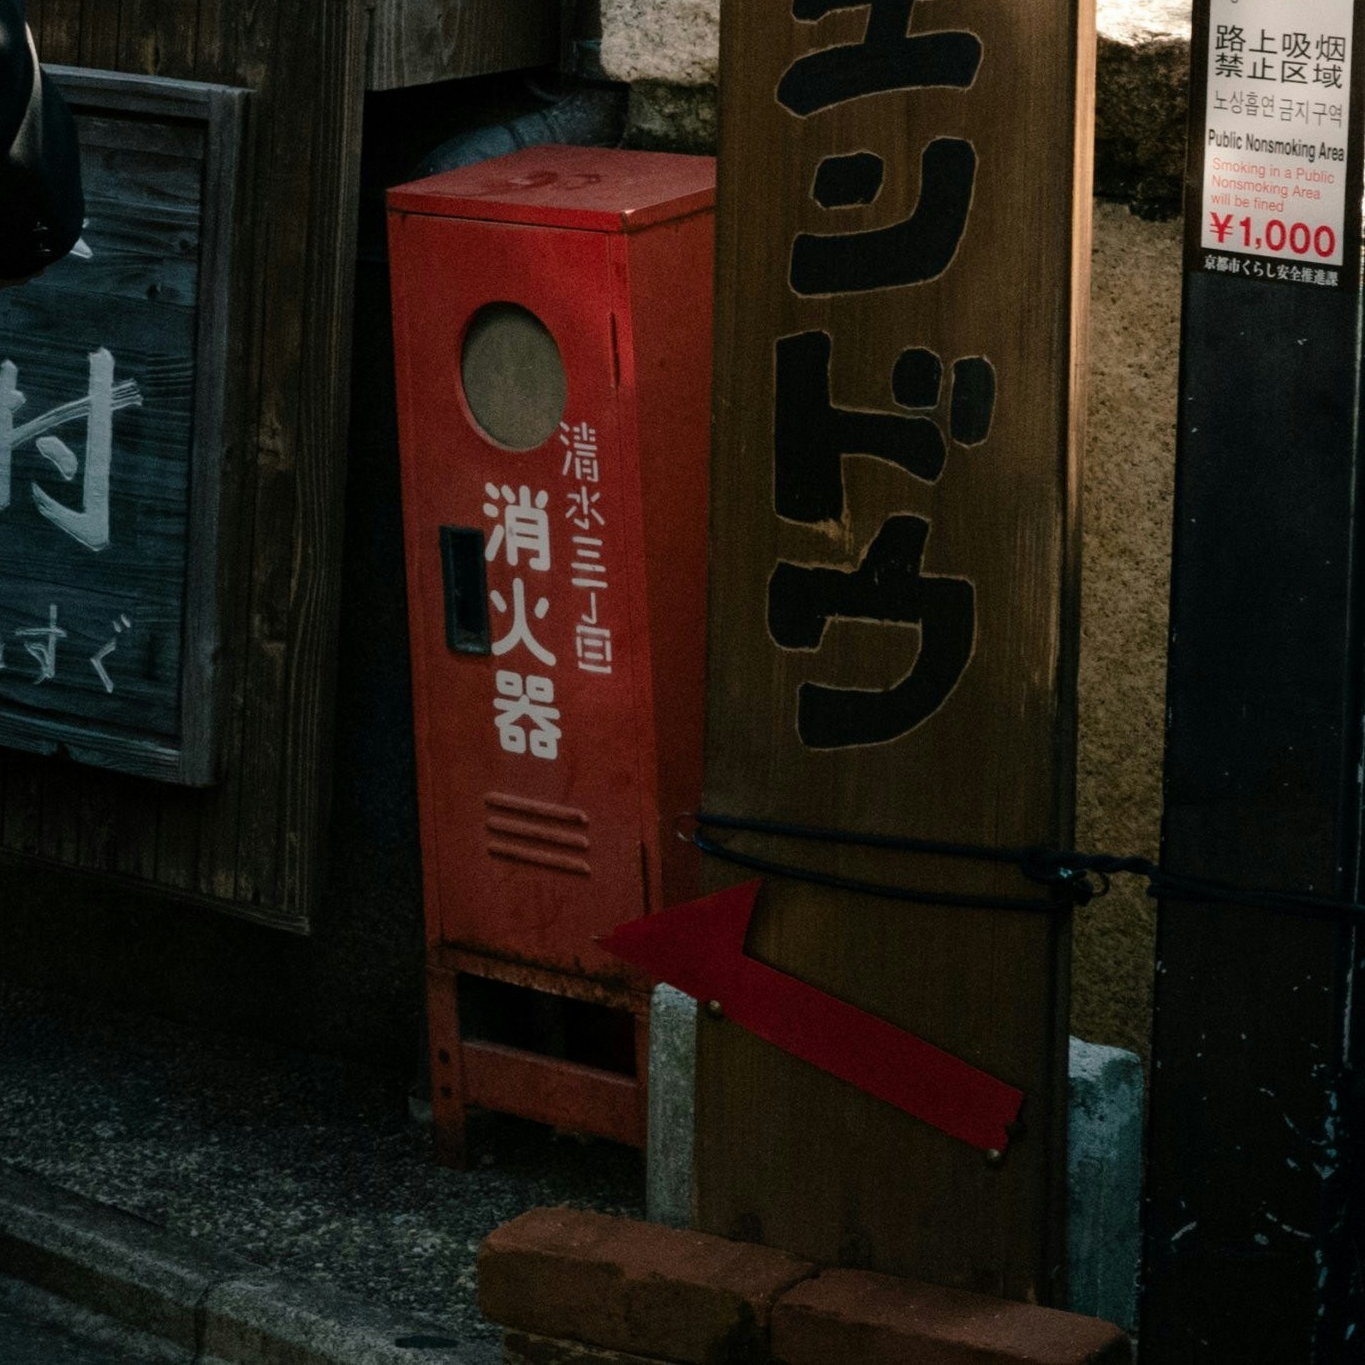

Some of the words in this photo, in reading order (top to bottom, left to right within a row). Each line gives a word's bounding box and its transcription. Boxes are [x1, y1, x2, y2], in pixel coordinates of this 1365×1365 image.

[1215, 24, 1346, 63] 路上吸烟
[1214, 52, 1343, 89] 禁止区域
[1208, 128, 1243, 150] Public
[1245, 132, 1316, 163] Nonsmoking
[1318, 141, 1345, 162] Area
[1211, 175, 1289, 199] Nonsmoking
[1292, 184, 1321, 201] Area
[1212, 157, 1266, 179] Smoking
[1269, 163, 1281, 177] in
[1284, 167, 1292, 179] a
[1295, 165, 1335, 185] Public
[1211, 192, 1231, 205] will
[1234, 195, 1250, 208] be
[1252, 197, 1285, 213] fined
[1209, 211, 1336, 258] ¥1,000
[1204, 254, 1340, 287] 京都市くらし安全推進課
[482, 482, 562, 761] 消火器
